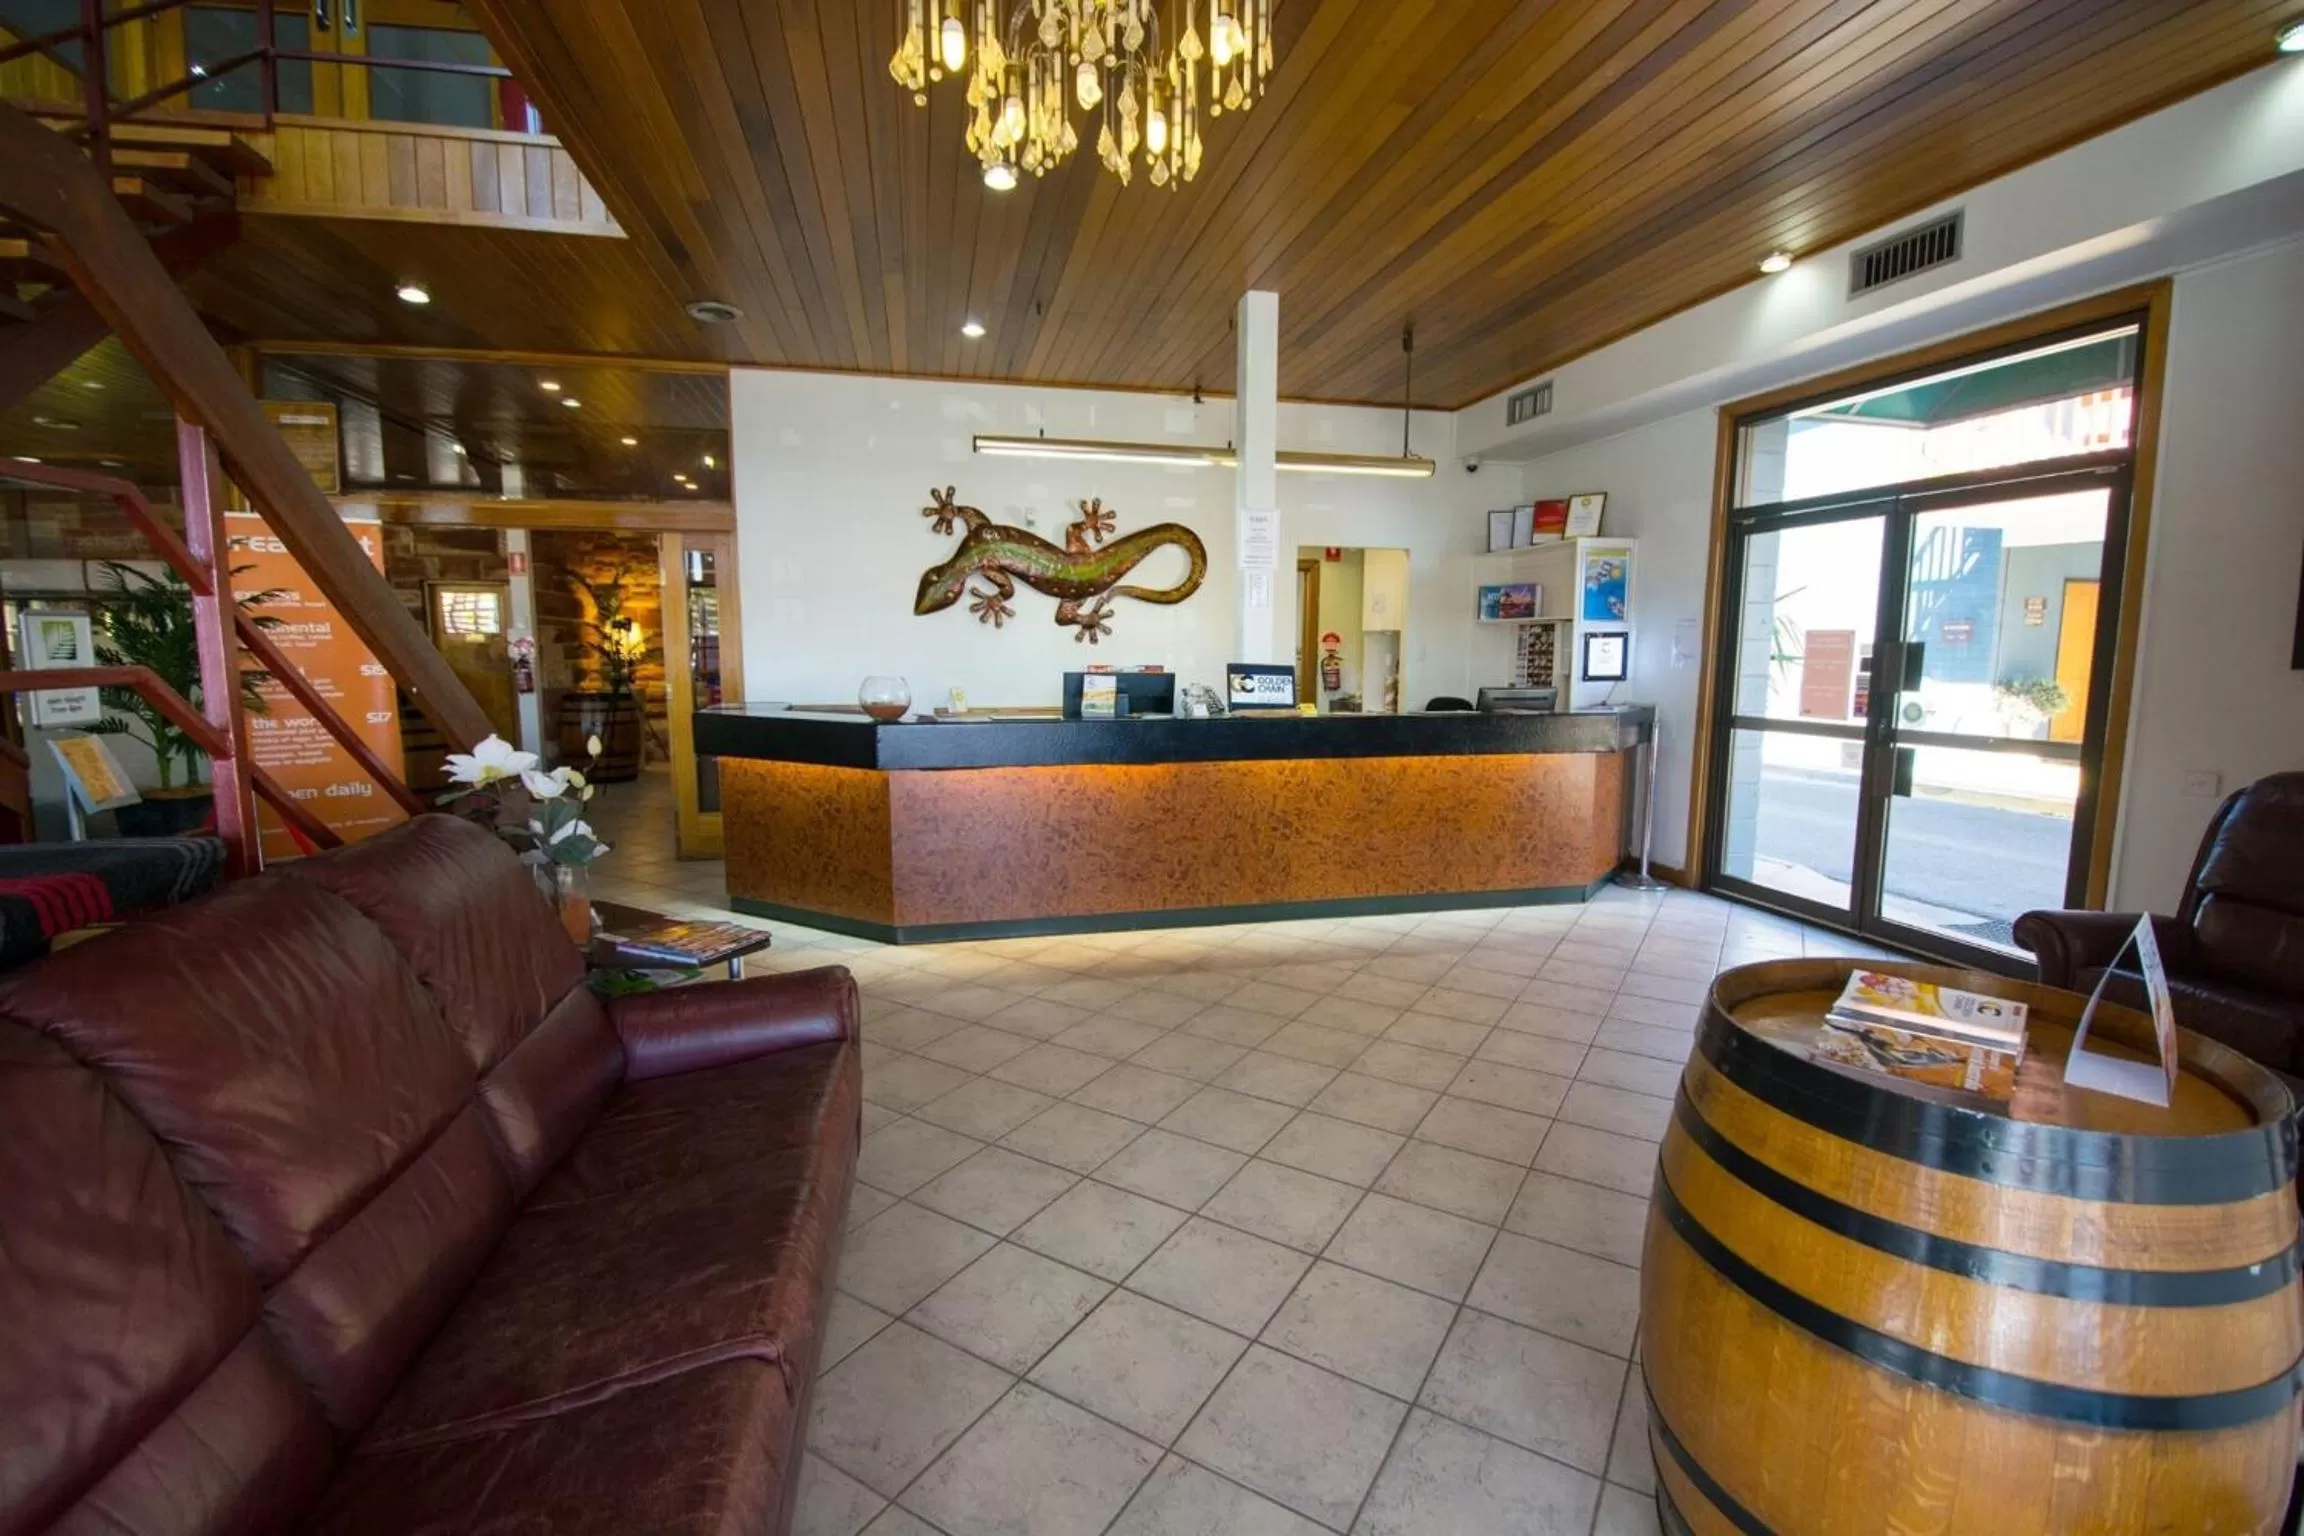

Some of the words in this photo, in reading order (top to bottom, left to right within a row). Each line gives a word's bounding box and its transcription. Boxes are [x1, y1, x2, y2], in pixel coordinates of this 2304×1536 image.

[1257, 676, 1292, 685] GOLDEN
[1257, 685, 1286, 693] CHAIN
[252, 717, 278, 729] the
[284, 716, 323, 729] wor
[325, 781, 372, 797] daily
